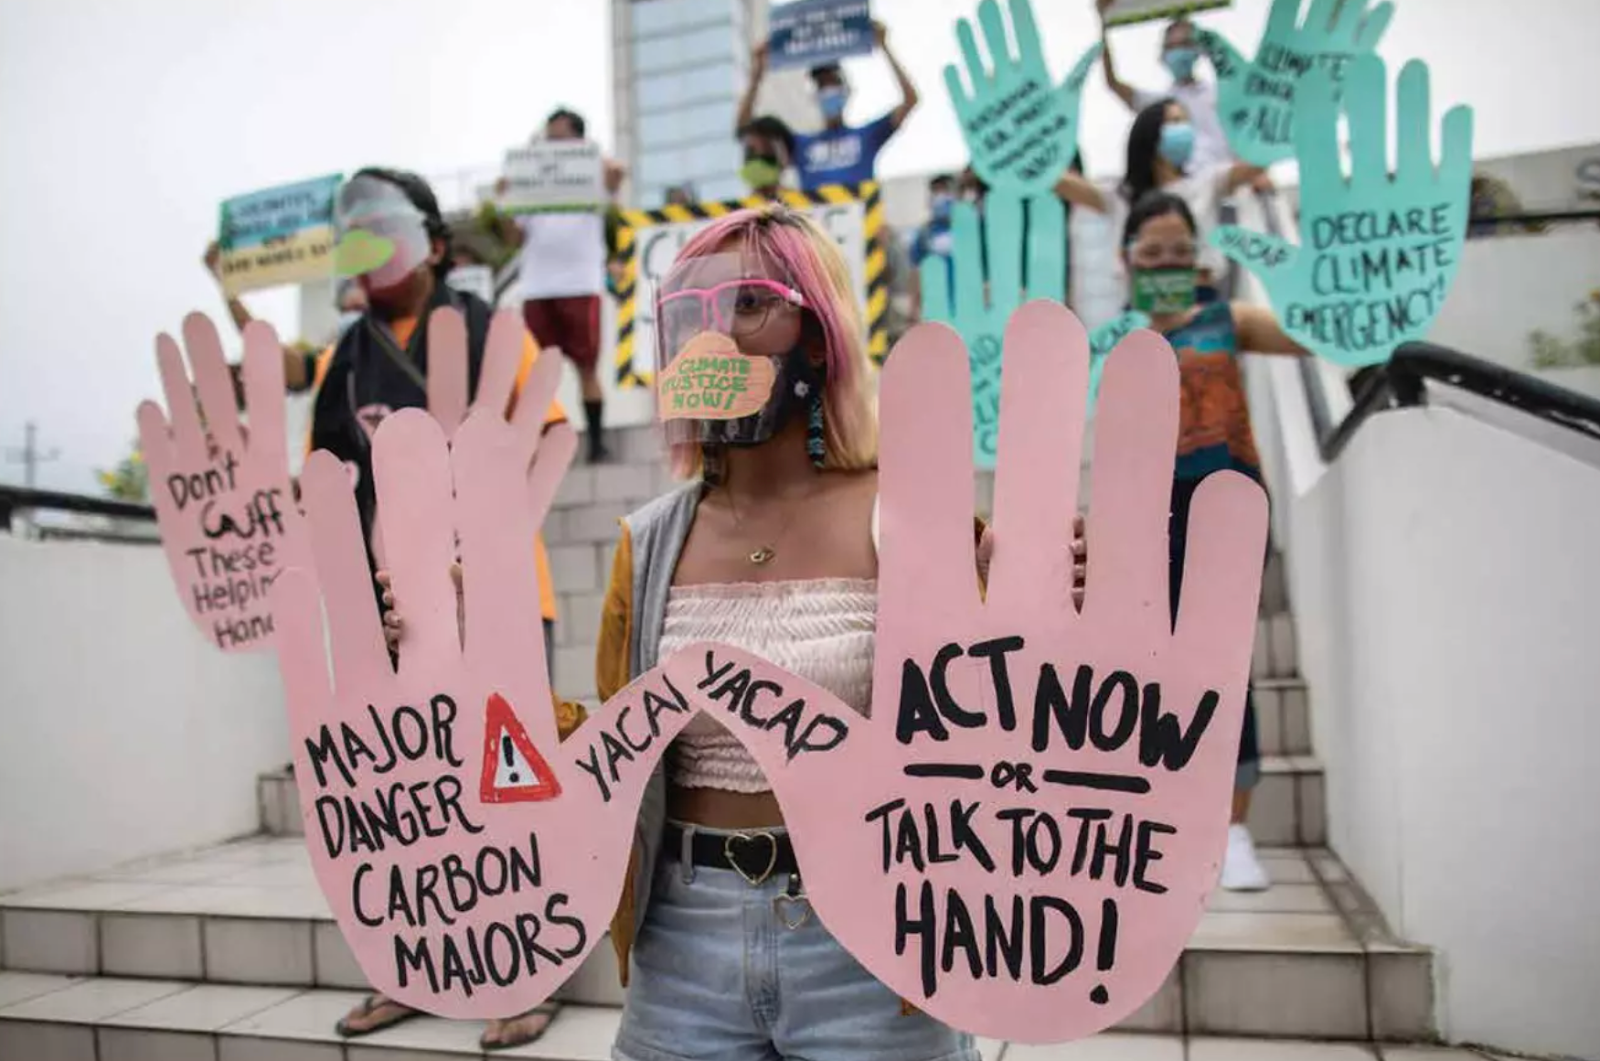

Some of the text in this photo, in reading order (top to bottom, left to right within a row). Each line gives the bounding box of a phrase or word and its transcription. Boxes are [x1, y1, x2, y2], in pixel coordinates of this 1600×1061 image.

[1312, 203, 1453, 250] DECLARE
[1312, 237, 1455, 296] CLIMATE
[1286, 273, 1446, 352] EMERGENCY!
[661, 374, 748, 396] JUSTICE
[674, 390, 736, 410] NOW!
[679, 358, 751, 374] CLIMATE
[186, 542, 274, 579] These
[305, 694, 464, 788] MAJOR
[895, 635, 1220, 772] ACT NOW
[990, 760, 1039, 793] OR
[315, 775, 485, 859] DANGER
[865, 798, 1178, 895] TALK TO THE
[352, 832, 542, 927] CARBON
[394, 892, 586, 998] MAJORS
[895, 879, 1118, 1005] HAND!
